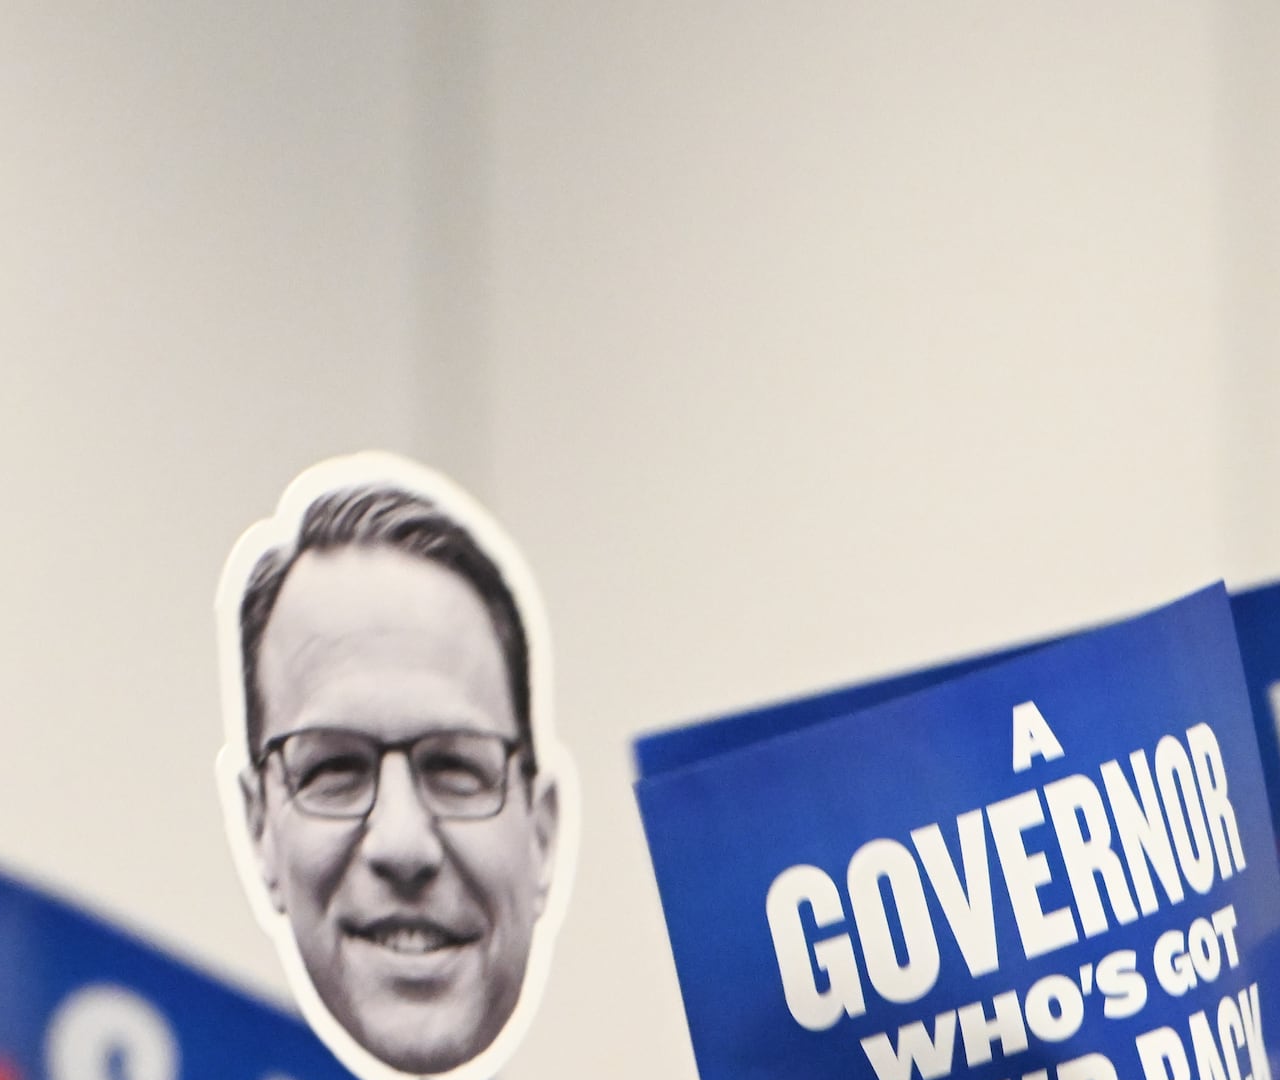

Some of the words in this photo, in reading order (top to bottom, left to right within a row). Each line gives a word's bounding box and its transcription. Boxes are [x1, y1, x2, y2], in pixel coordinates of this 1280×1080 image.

[1012, 701, 1064, 773] A
[765, 722, 1246, 1032] GOVERNOR
[1154, 905, 1240, 997] GOT
